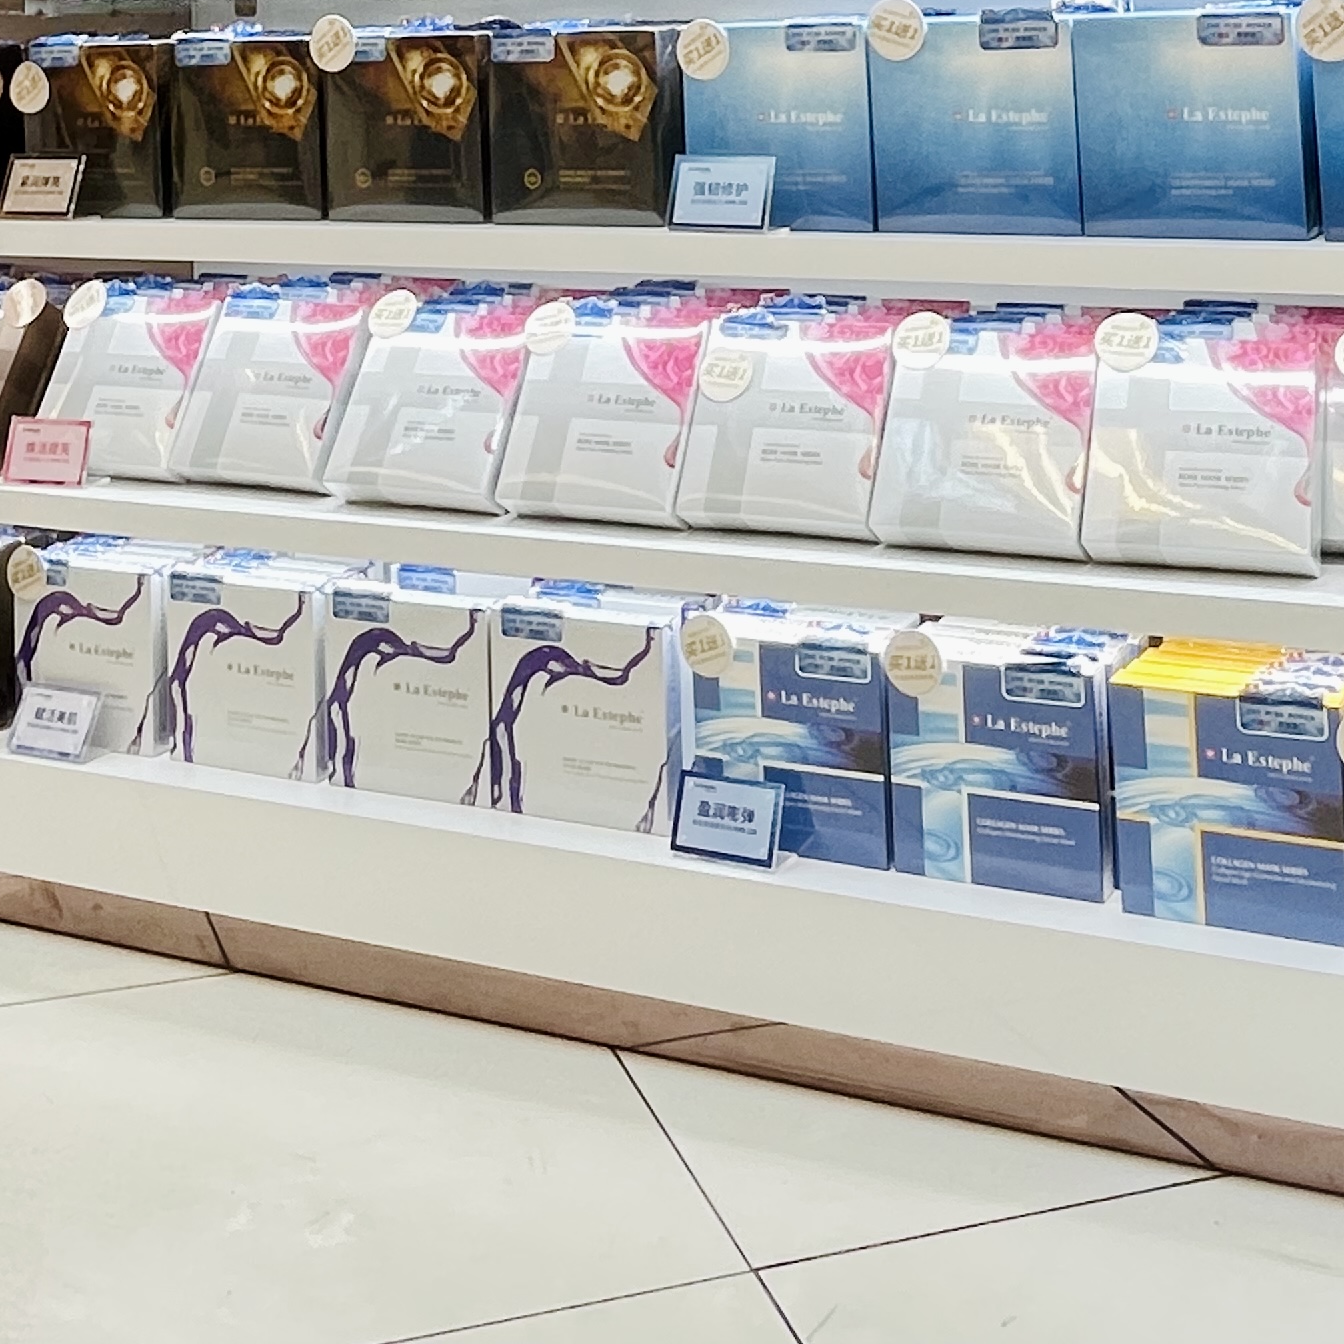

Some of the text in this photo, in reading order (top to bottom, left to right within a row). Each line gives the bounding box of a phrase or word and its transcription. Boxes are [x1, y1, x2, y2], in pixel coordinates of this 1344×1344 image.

[1183, 105, 1270, 124] La Estephe
[781, 402, 796, 414] La
[981, 414, 996, 426] La
[1195, 423, 1272, 441] La Estephe
[405, 682, 421, 696] La
[780, 691, 856, 716] La Estephe
[574, 705, 644, 727] La Estephe
[985, 713, 1070, 739] La Estephe
[1220, 747, 1313, 776] La Estephe
